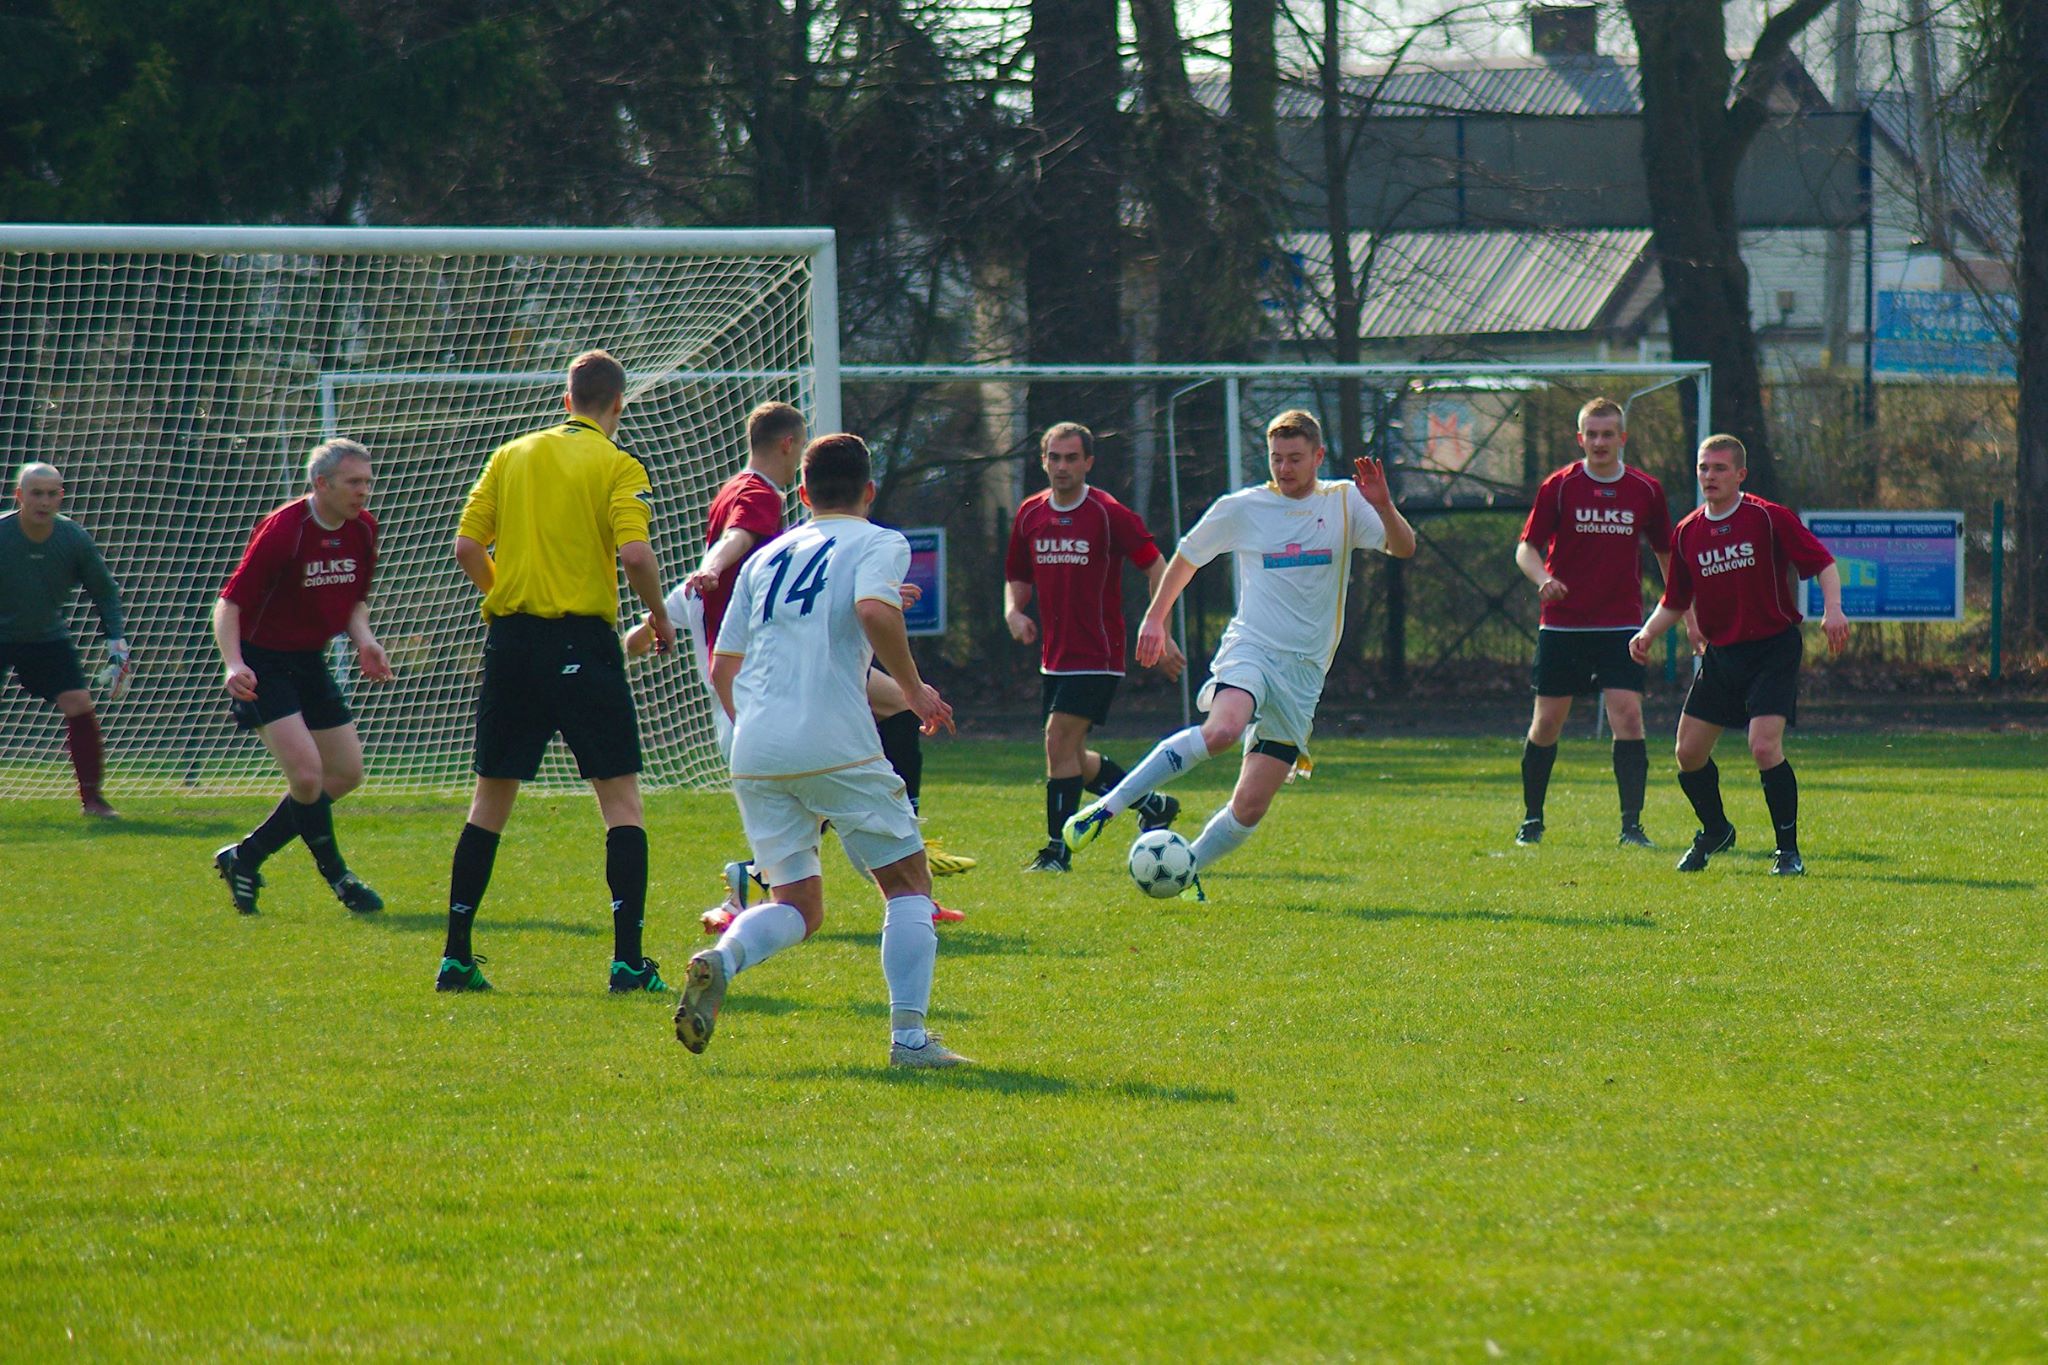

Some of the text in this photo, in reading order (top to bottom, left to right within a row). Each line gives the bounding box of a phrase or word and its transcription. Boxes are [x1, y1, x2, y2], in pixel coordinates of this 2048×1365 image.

[1575, 508, 1634, 524] ULKS
[1036, 538, 1090, 554] ULKS
[1697, 542, 1754, 566] ULKS
[306, 558, 357, 576] ULKS
[762, 535, 837, 625] 14
